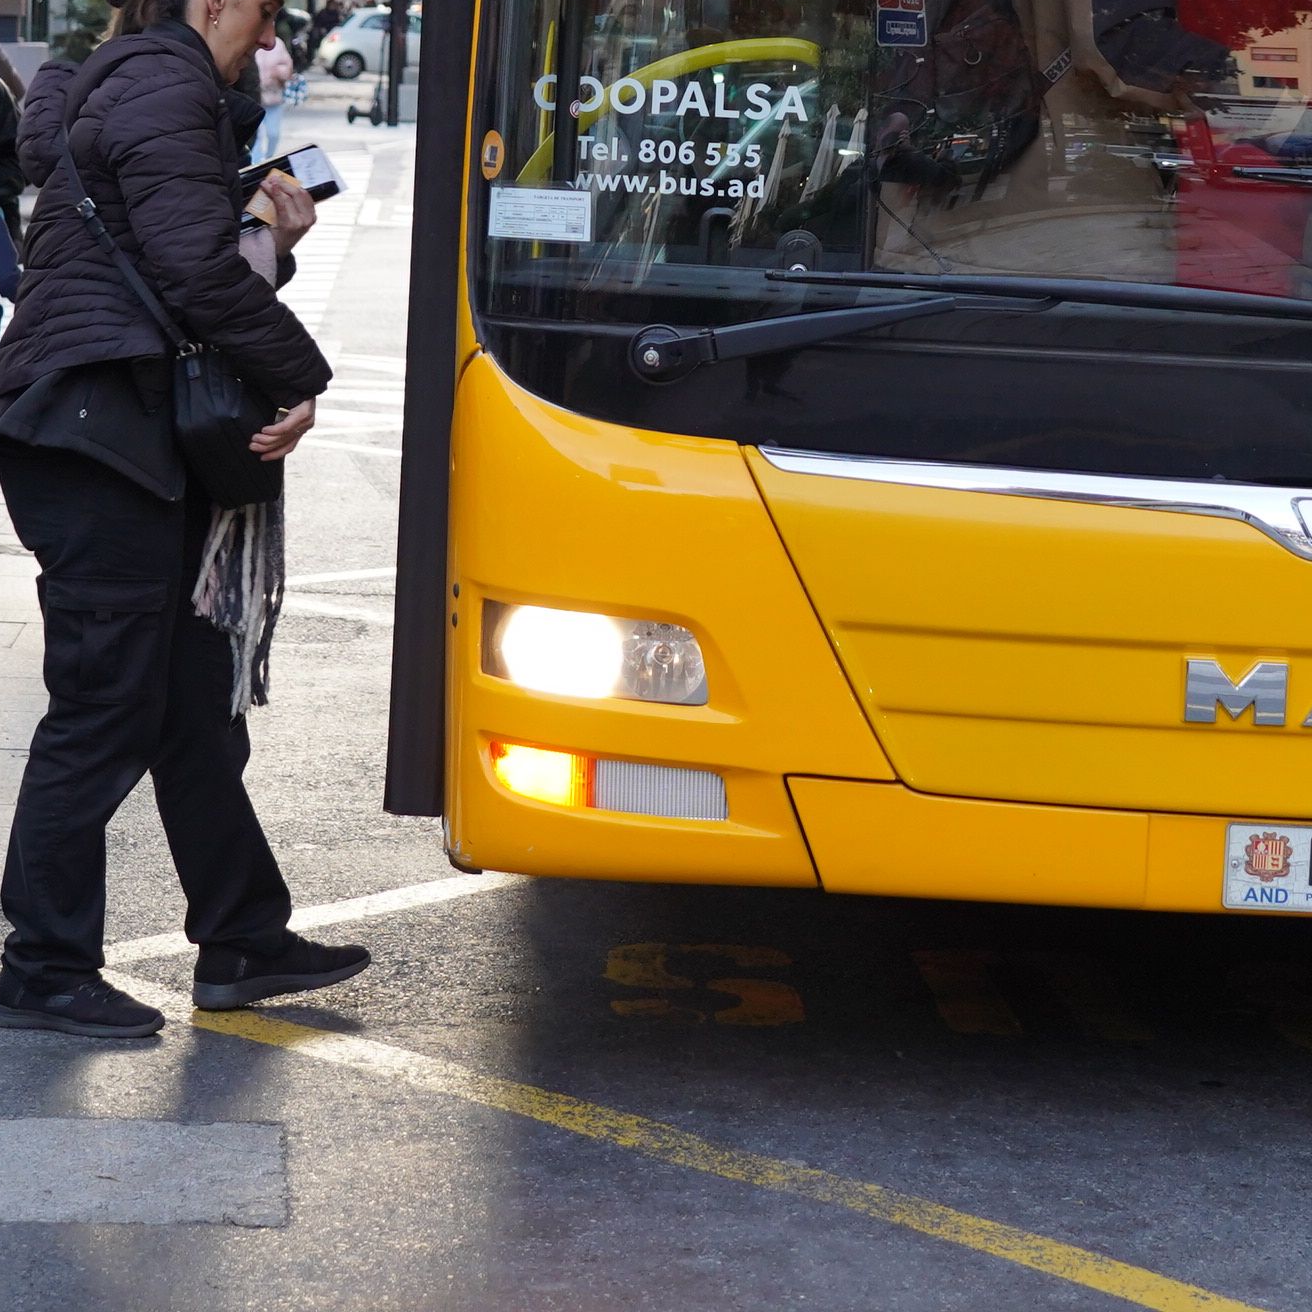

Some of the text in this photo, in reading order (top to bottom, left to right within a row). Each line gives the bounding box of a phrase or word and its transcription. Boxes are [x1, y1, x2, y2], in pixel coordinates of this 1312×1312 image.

[533, 73, 809, 122] COOPALSA
[577, 135, 762, 169] Tel. 806 555
[565, 170, 765, 199] www.bus.ad
[1243, 887, 1289, 905] AND
